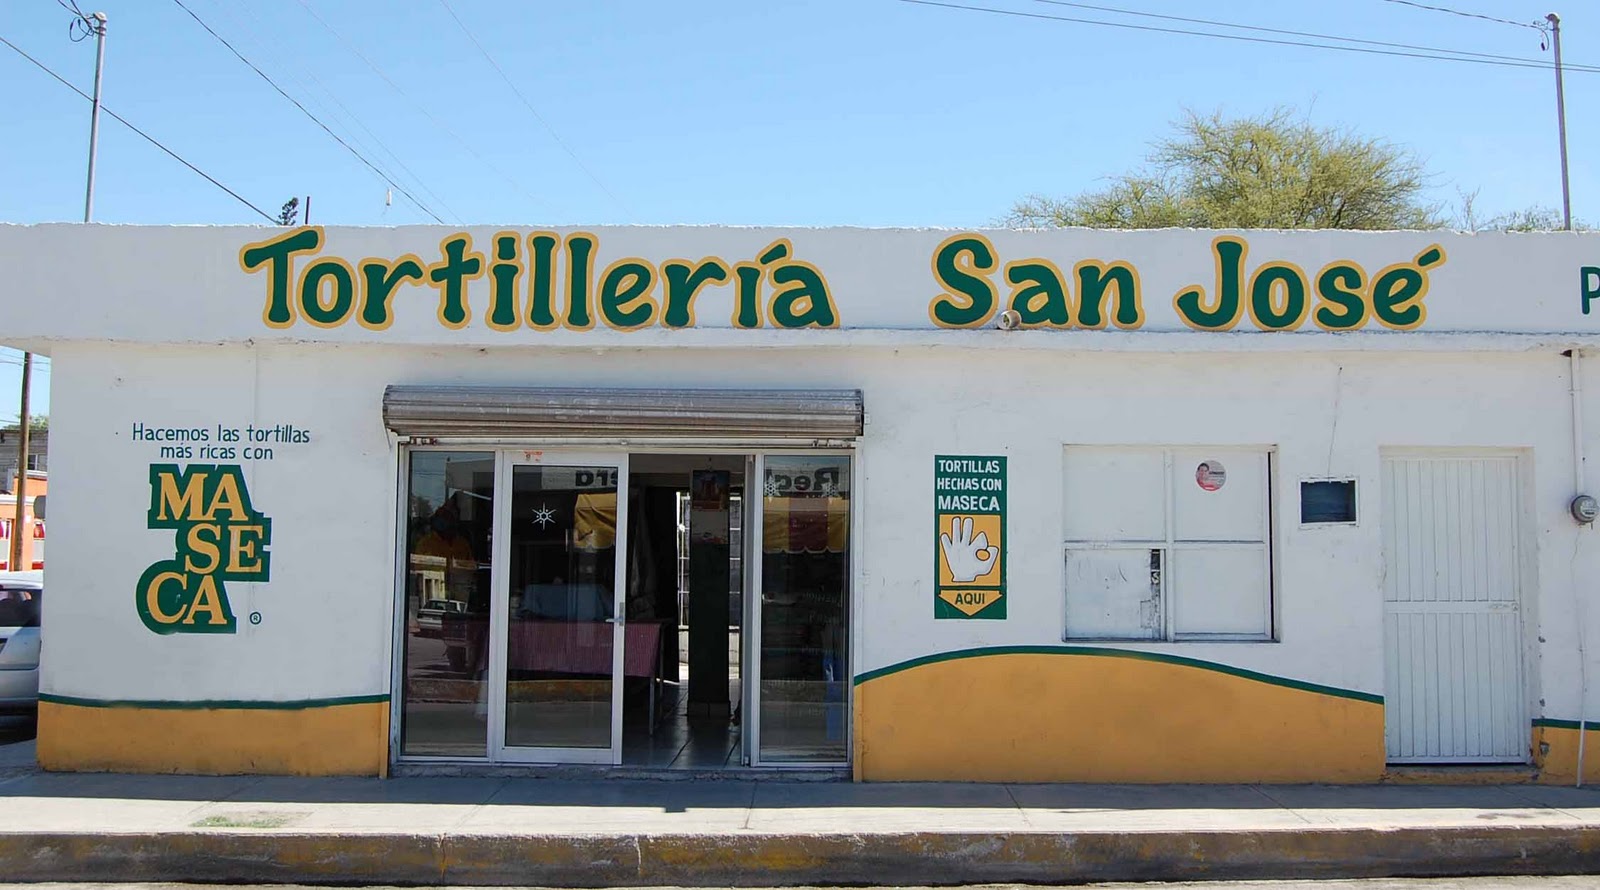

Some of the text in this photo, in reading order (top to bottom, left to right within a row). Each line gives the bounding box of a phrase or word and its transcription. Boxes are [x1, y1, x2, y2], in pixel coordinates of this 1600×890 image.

[239, 226, 1446, 331] Tortillería San José
[132, 422, 310, 443] Hacemos las tortillas
[160, 442, 273, 459] más ricas con
[938, 459, 1000, 473] TORTILLAS
[937, 477, 1002, 491] HECHAS CON
[938, 495, 1000, 511] MASECA
[954, 592, 985, 606] AQUI
